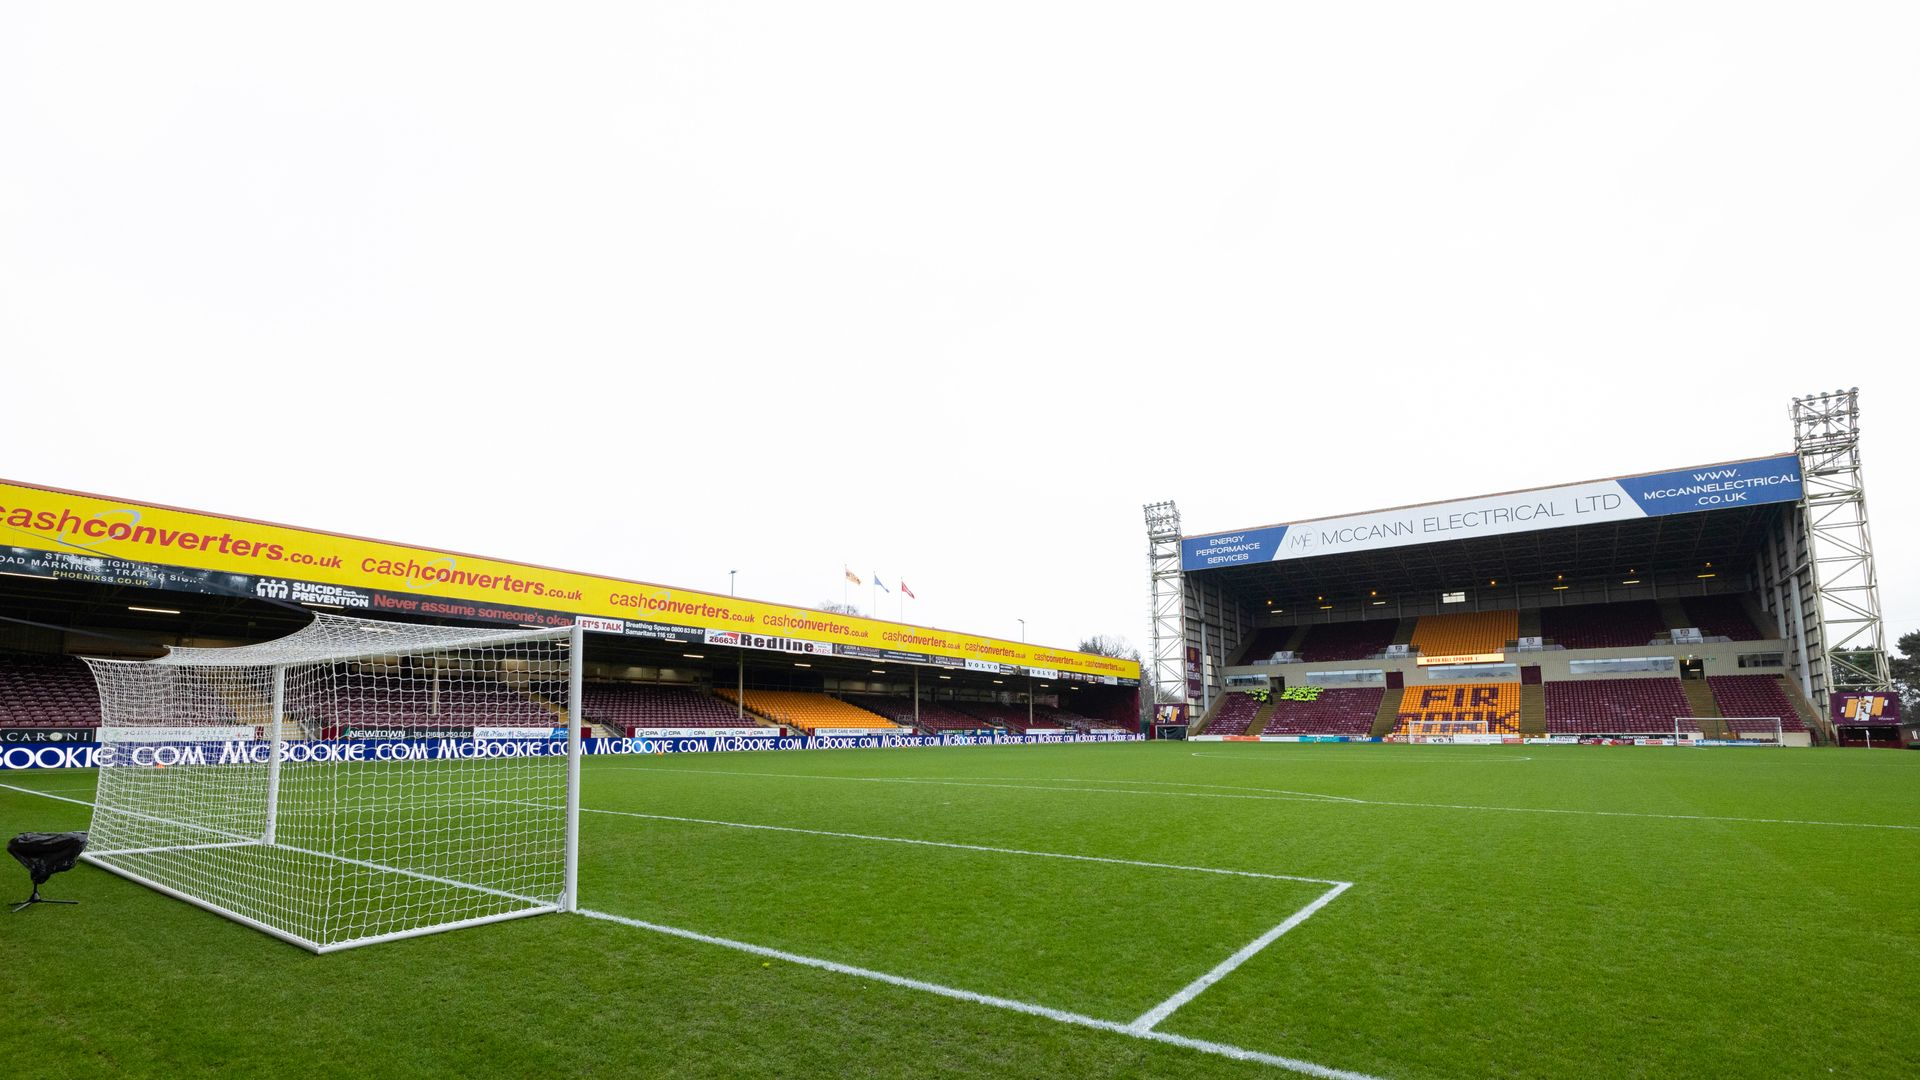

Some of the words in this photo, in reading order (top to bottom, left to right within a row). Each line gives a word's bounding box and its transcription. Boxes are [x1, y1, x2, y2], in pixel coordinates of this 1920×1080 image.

[1692, 468, 1741, 482] WWW.
[1643, 473, 1800, 501] MCCANNELECTRICAL
[1694, 492, 1747, 506] .CO.UK
[1321, 520, 1413, 545] MCCANN
[1423, 504, 1565, 533] ELECTRICAL
[1575, 492, 1622, 514] LTD
[1209, 535, 1245, 547] ENERGY
[1196, 542, 1261, 557] PERFORMANCE
[1207, 553, 1249, 565] SERVICES
[361, 557, 583, 601] cashconverters.co.uk
[293, 582, 342, 596] SUICIDE
[292, 592, 368, 607] PREVENTION
[373, 594, 419, 610] Never
[421, 603, 475, 617] assume
[478, 608, 544, 624] someone's
[609, 592, 755, 623] cashconverters.co.uk
[602, 622, 622, 631] TALK
[625, 621, 653, 631] Breathing
[653, 624, 670, 633] Space
[625, 629, 657, 638] Samaritans
[762, 614, 869, 639] cashconverters.co.uk
[709, 635, 738, 645] 266633
[740, 633, 814, 653] Redline
[882, 630, 961, 650] cashconverters.co.uk
[967, 662, 998, 670] VOLVO
[1031, 669, 1057, 677] VOLVO
[1420, 687, 1499, 708] FIR
[349, 730, 406, 738] NEWTOWN
[0, 745, 206, 770] OOKIE.COM
